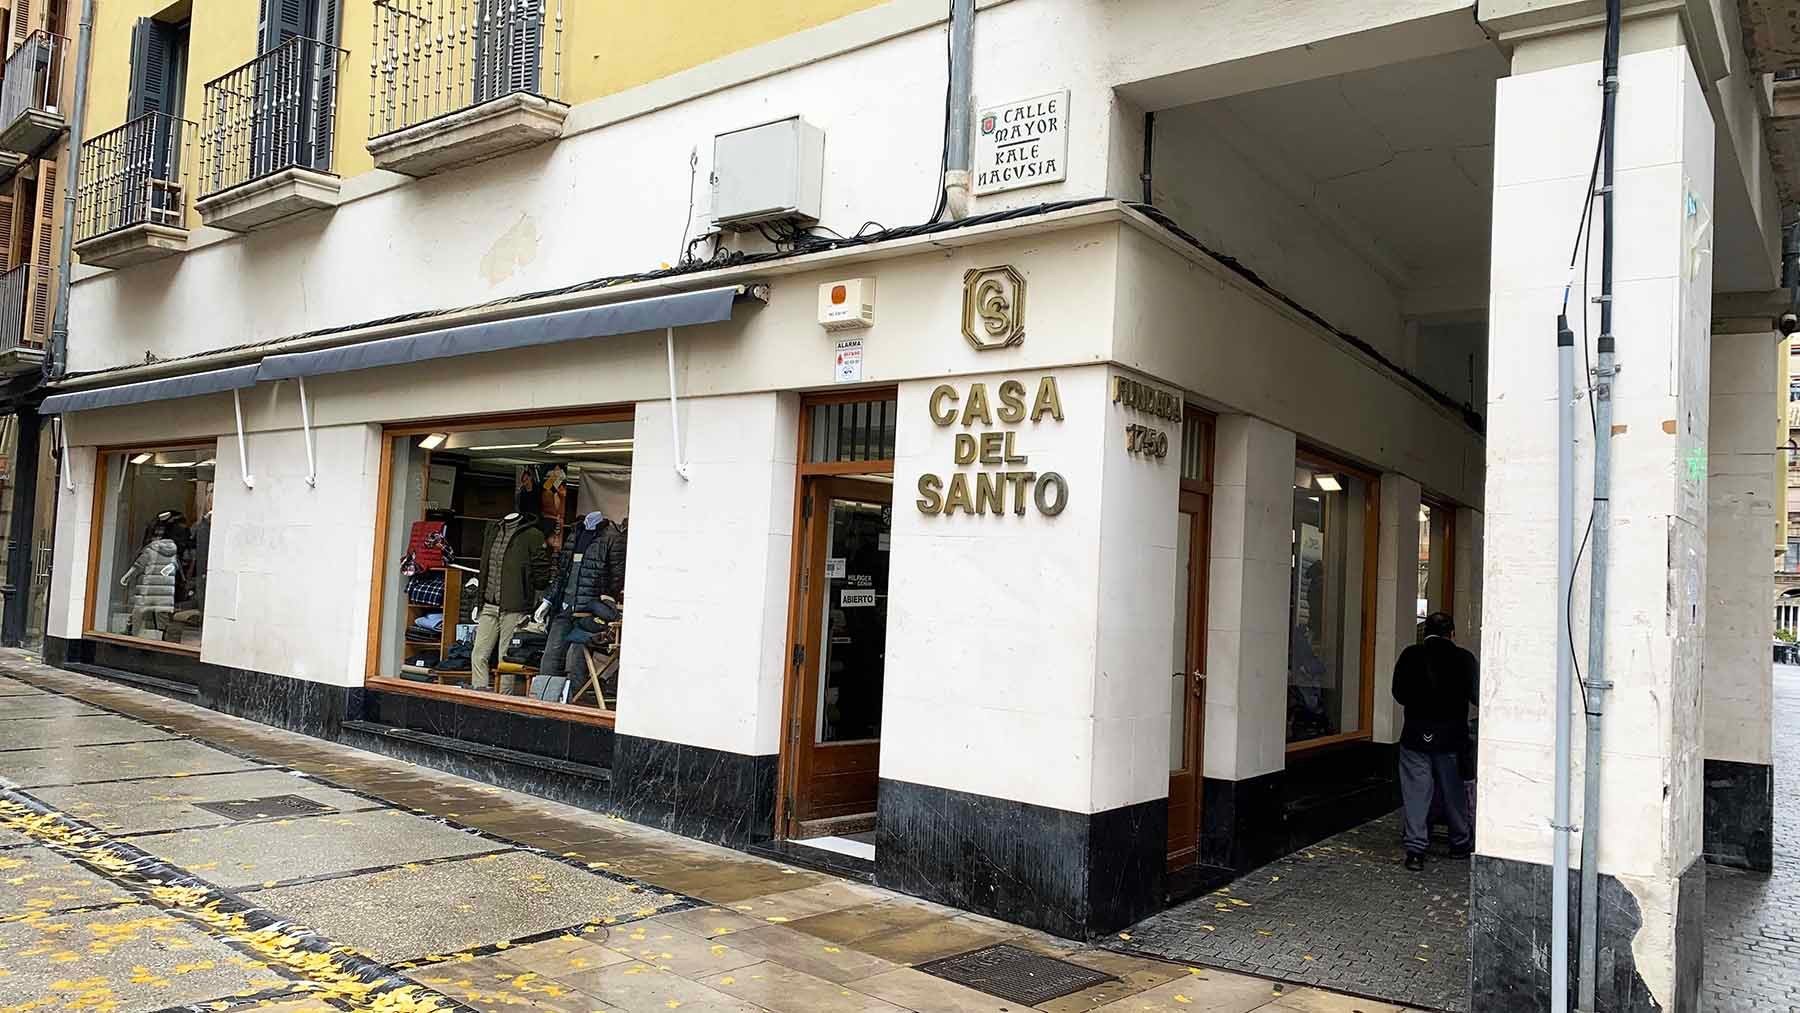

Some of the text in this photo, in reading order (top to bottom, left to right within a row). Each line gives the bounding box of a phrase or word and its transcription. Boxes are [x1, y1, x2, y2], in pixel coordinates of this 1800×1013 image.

[1004, 99, 1057, 124] CALLE
[994, 117, 1058, 143] MAYOR
[995, 144, 1040, 165] KALE
[837, 340, 862, 349] ALARMA
[928, 375, 1065, 426] CASA
[953, 430, 1028, 465] DEL
[1125, 423, 1169, 457] 1750
[916, 471, 1070, 517] SANTO
[842, 595, 873, 604] ABIERTO
